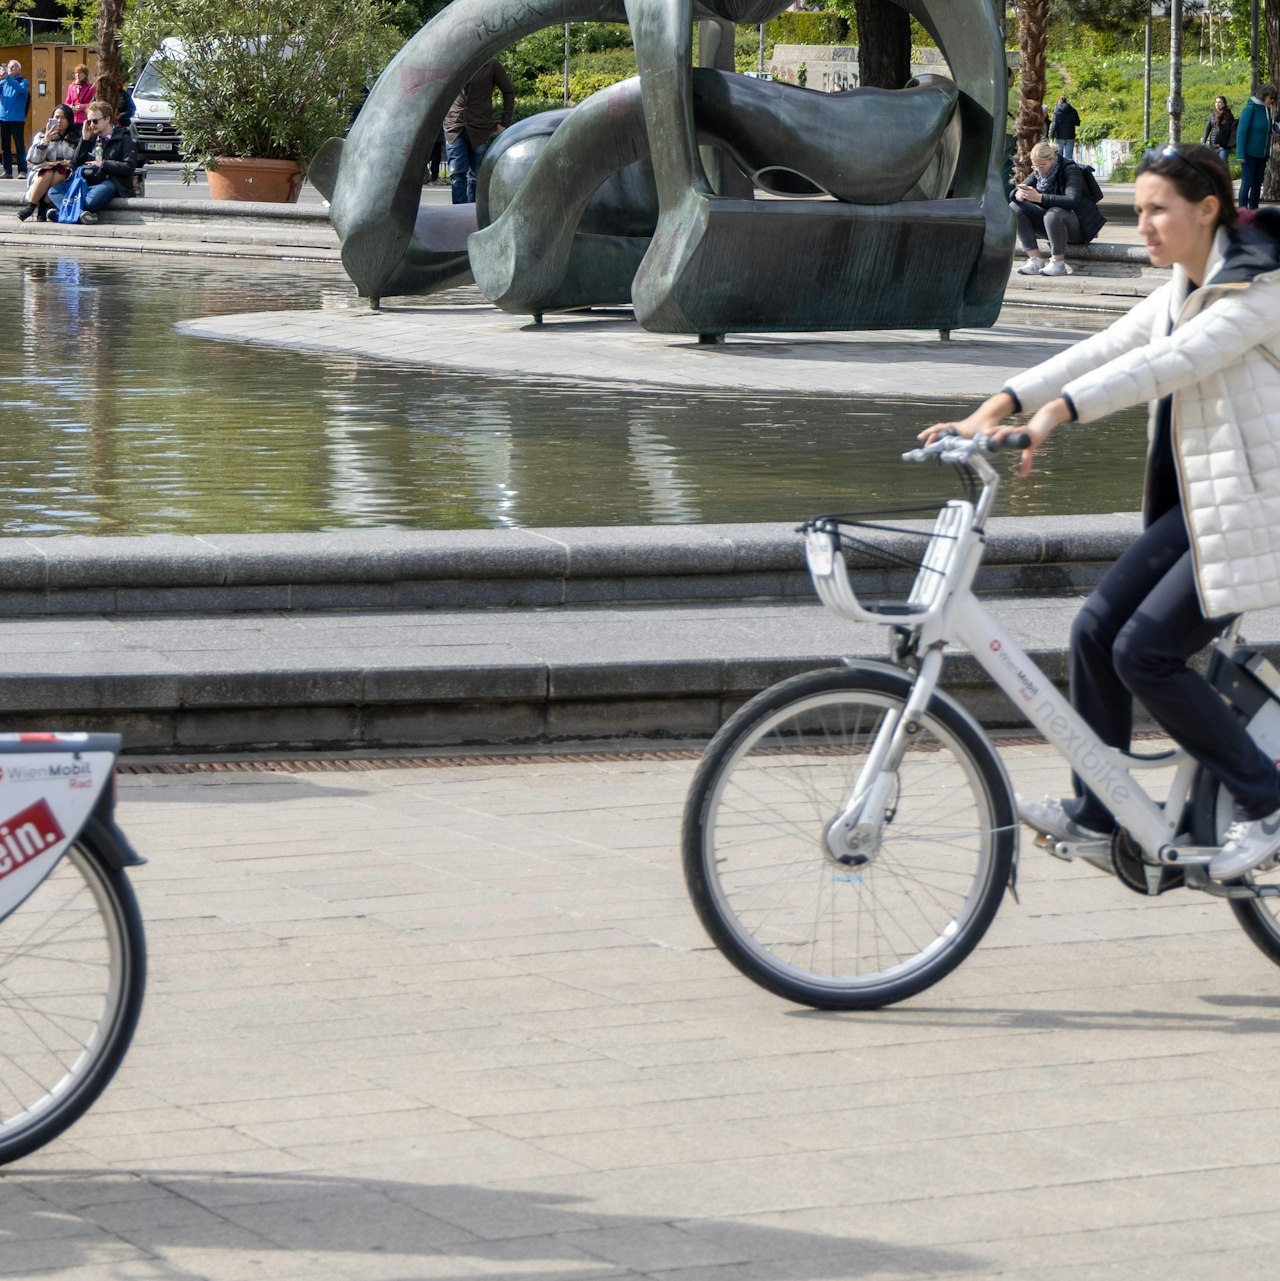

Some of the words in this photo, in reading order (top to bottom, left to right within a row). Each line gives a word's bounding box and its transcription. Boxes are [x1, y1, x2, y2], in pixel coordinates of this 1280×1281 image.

[1036, 700, 1130, 804] nextbike
[8, 761, 92, 780] WienMobil
[69, 778, 93, 789] Rad
